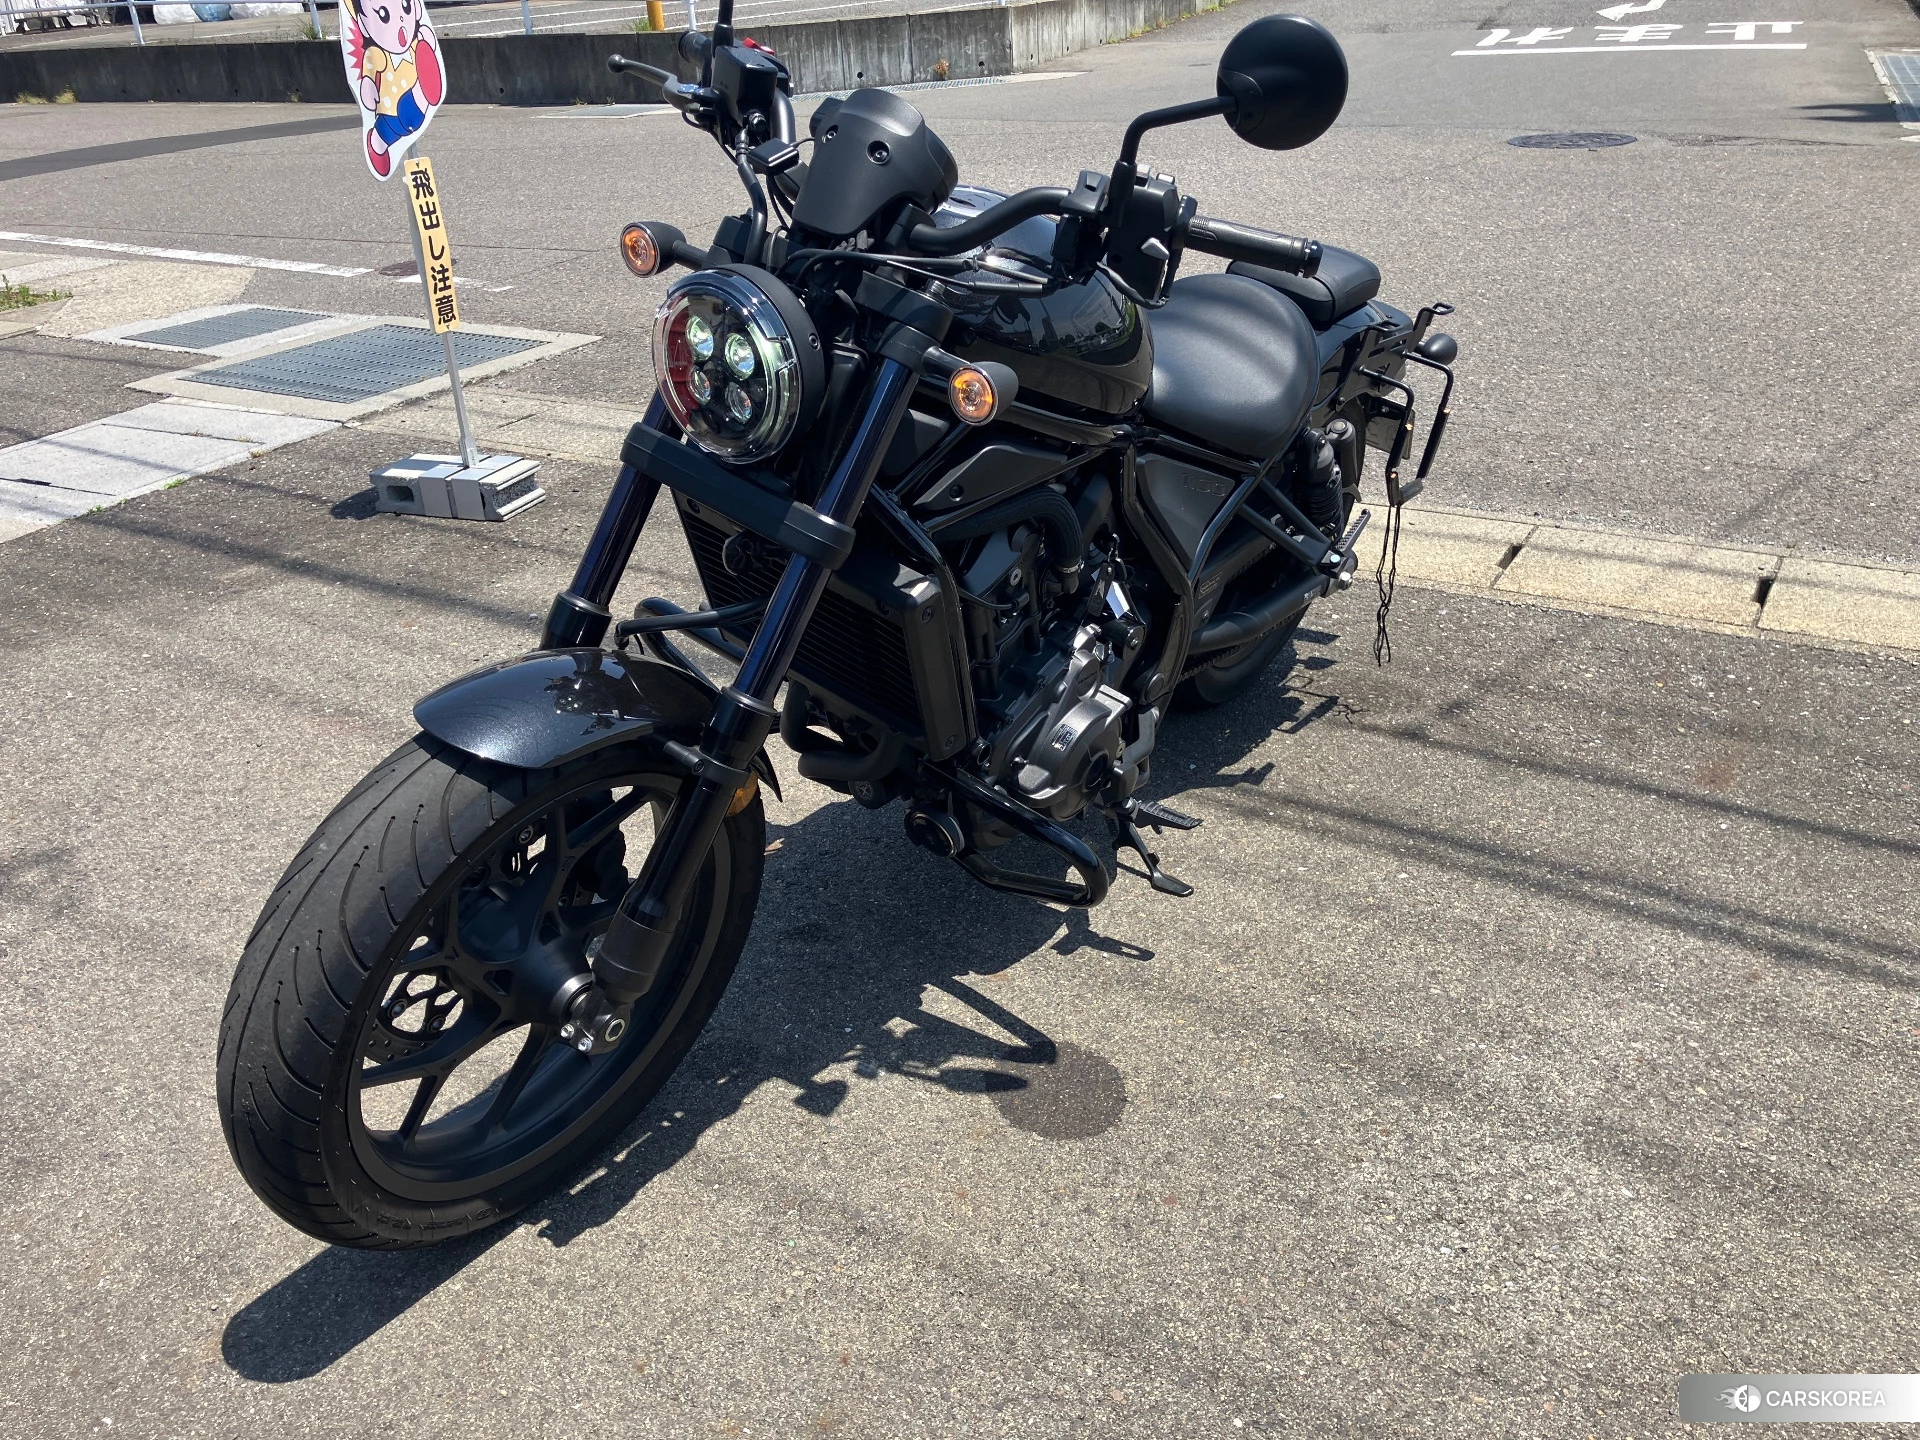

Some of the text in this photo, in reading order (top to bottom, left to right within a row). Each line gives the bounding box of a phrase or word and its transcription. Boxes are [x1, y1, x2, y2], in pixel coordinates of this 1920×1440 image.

[1476, 21, 1804, 47] 止まれ
[410, 167, 457, 325] 飛出し注意
